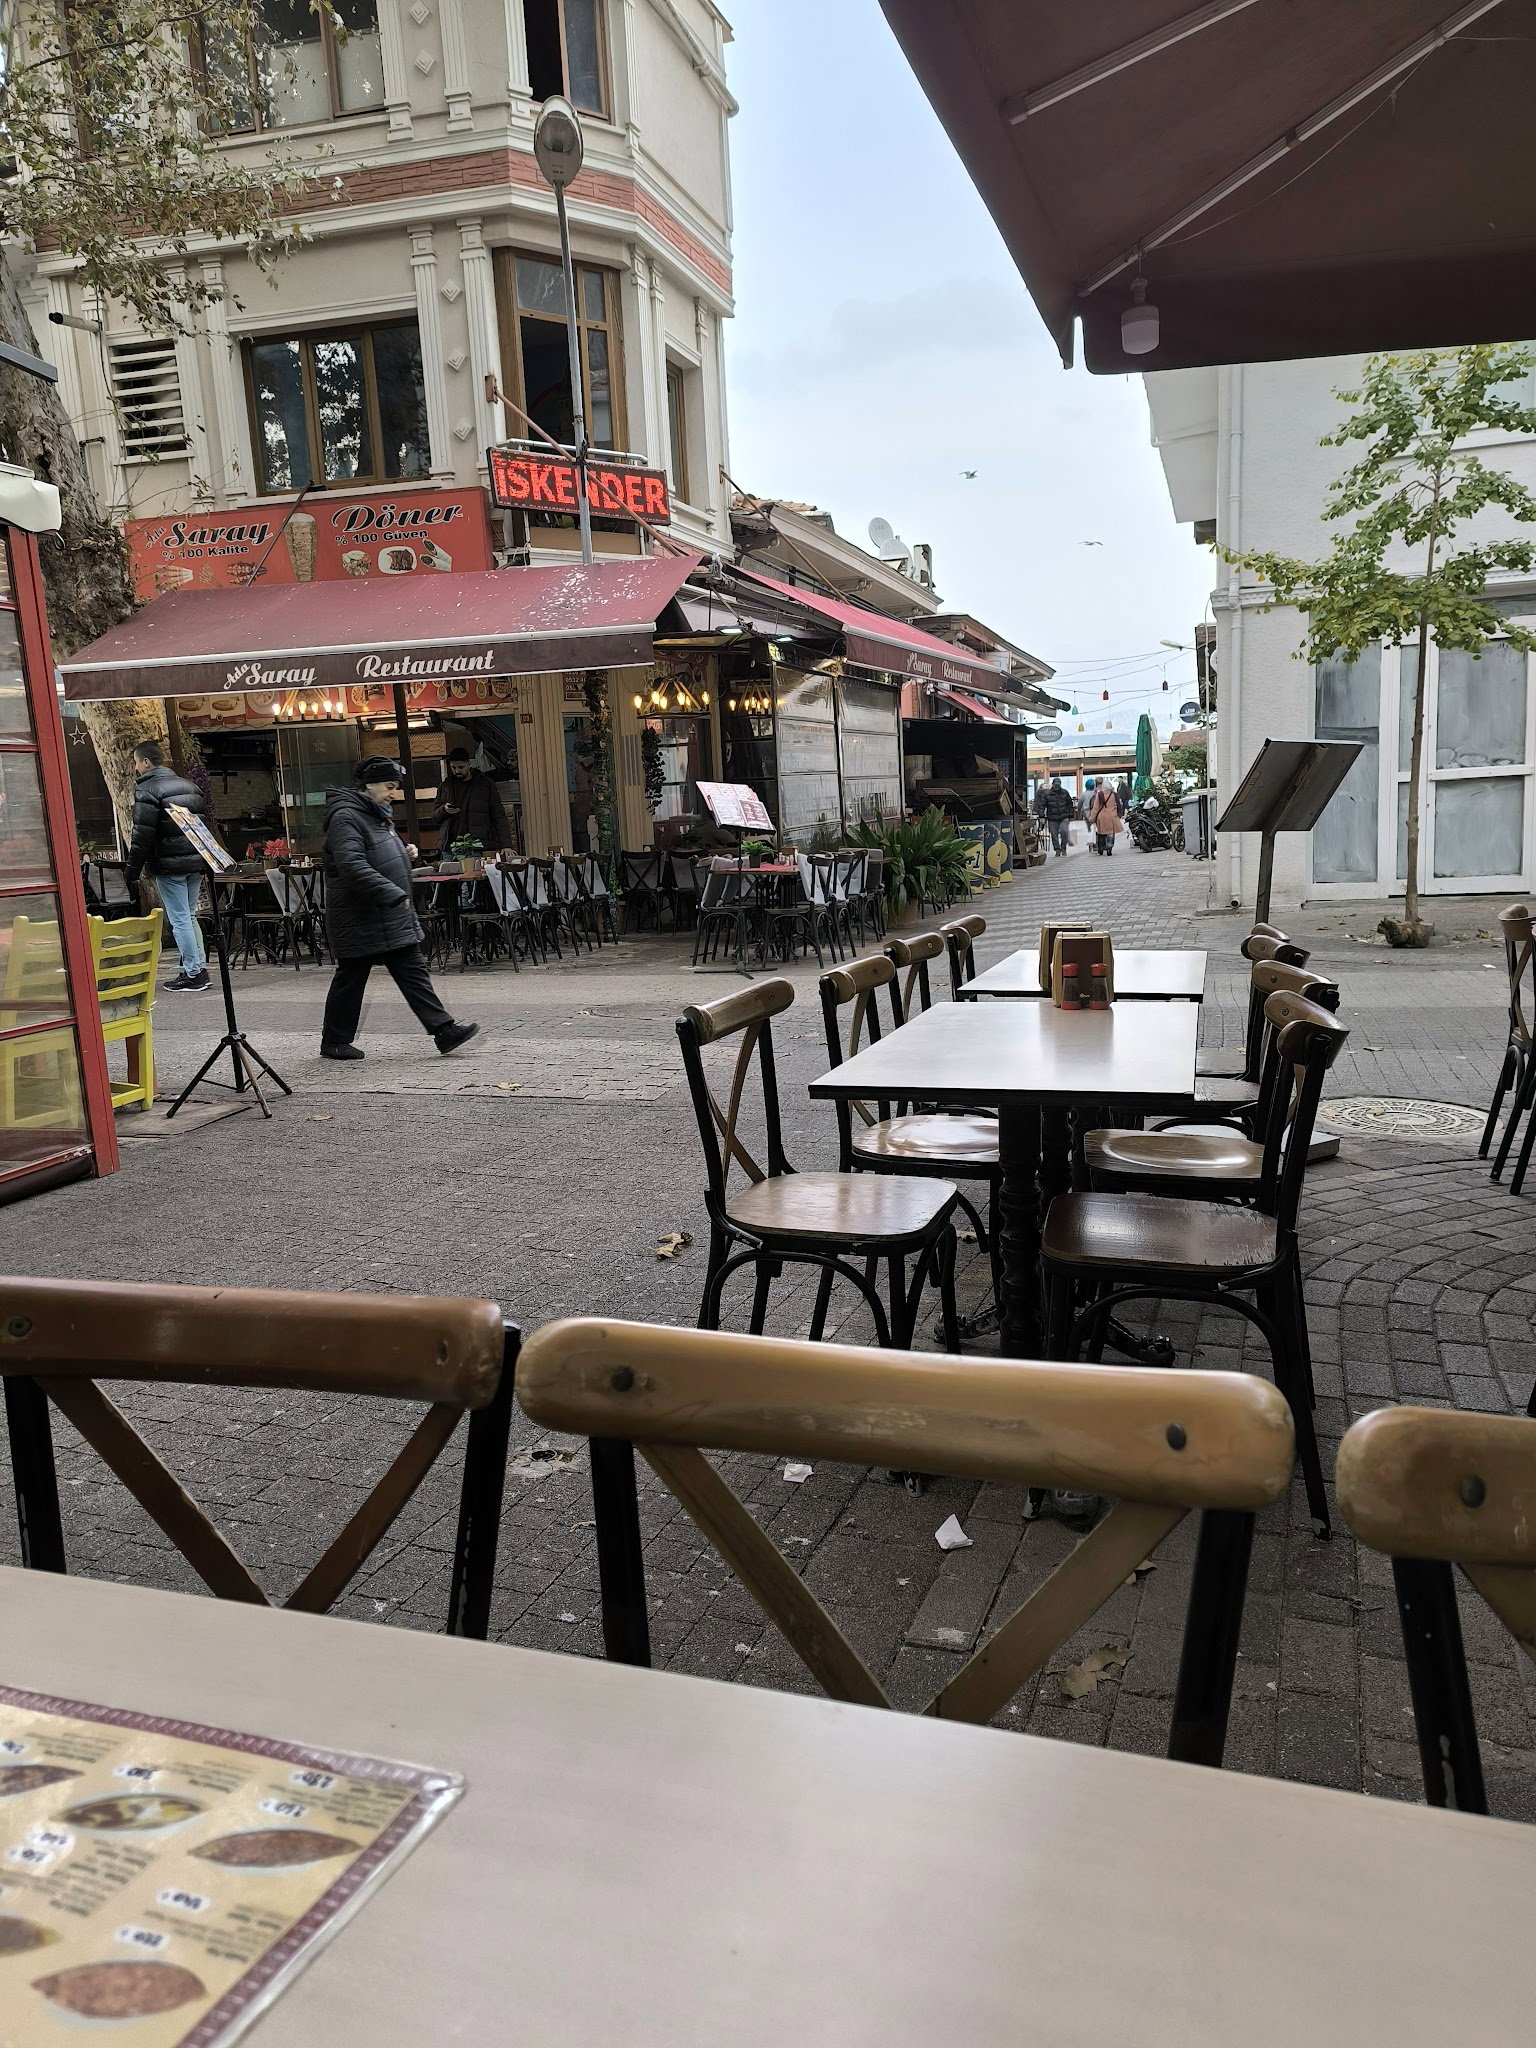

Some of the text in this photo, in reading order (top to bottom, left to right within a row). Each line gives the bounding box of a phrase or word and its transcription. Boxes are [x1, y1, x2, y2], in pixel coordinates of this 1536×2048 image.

[331, 504, 463, 533] Döner
[163, 521, 274, 549] Saray
[352, 533, 379, 544] 100
[383, 529, 428, 541] Güven
[179, 549, 203, 559] 100
[207, 545, 249, 557] Kalite
[223, 649, 496, 690] Ada Saray Restaurant
[941, 660, 973, 684] Restaurant
